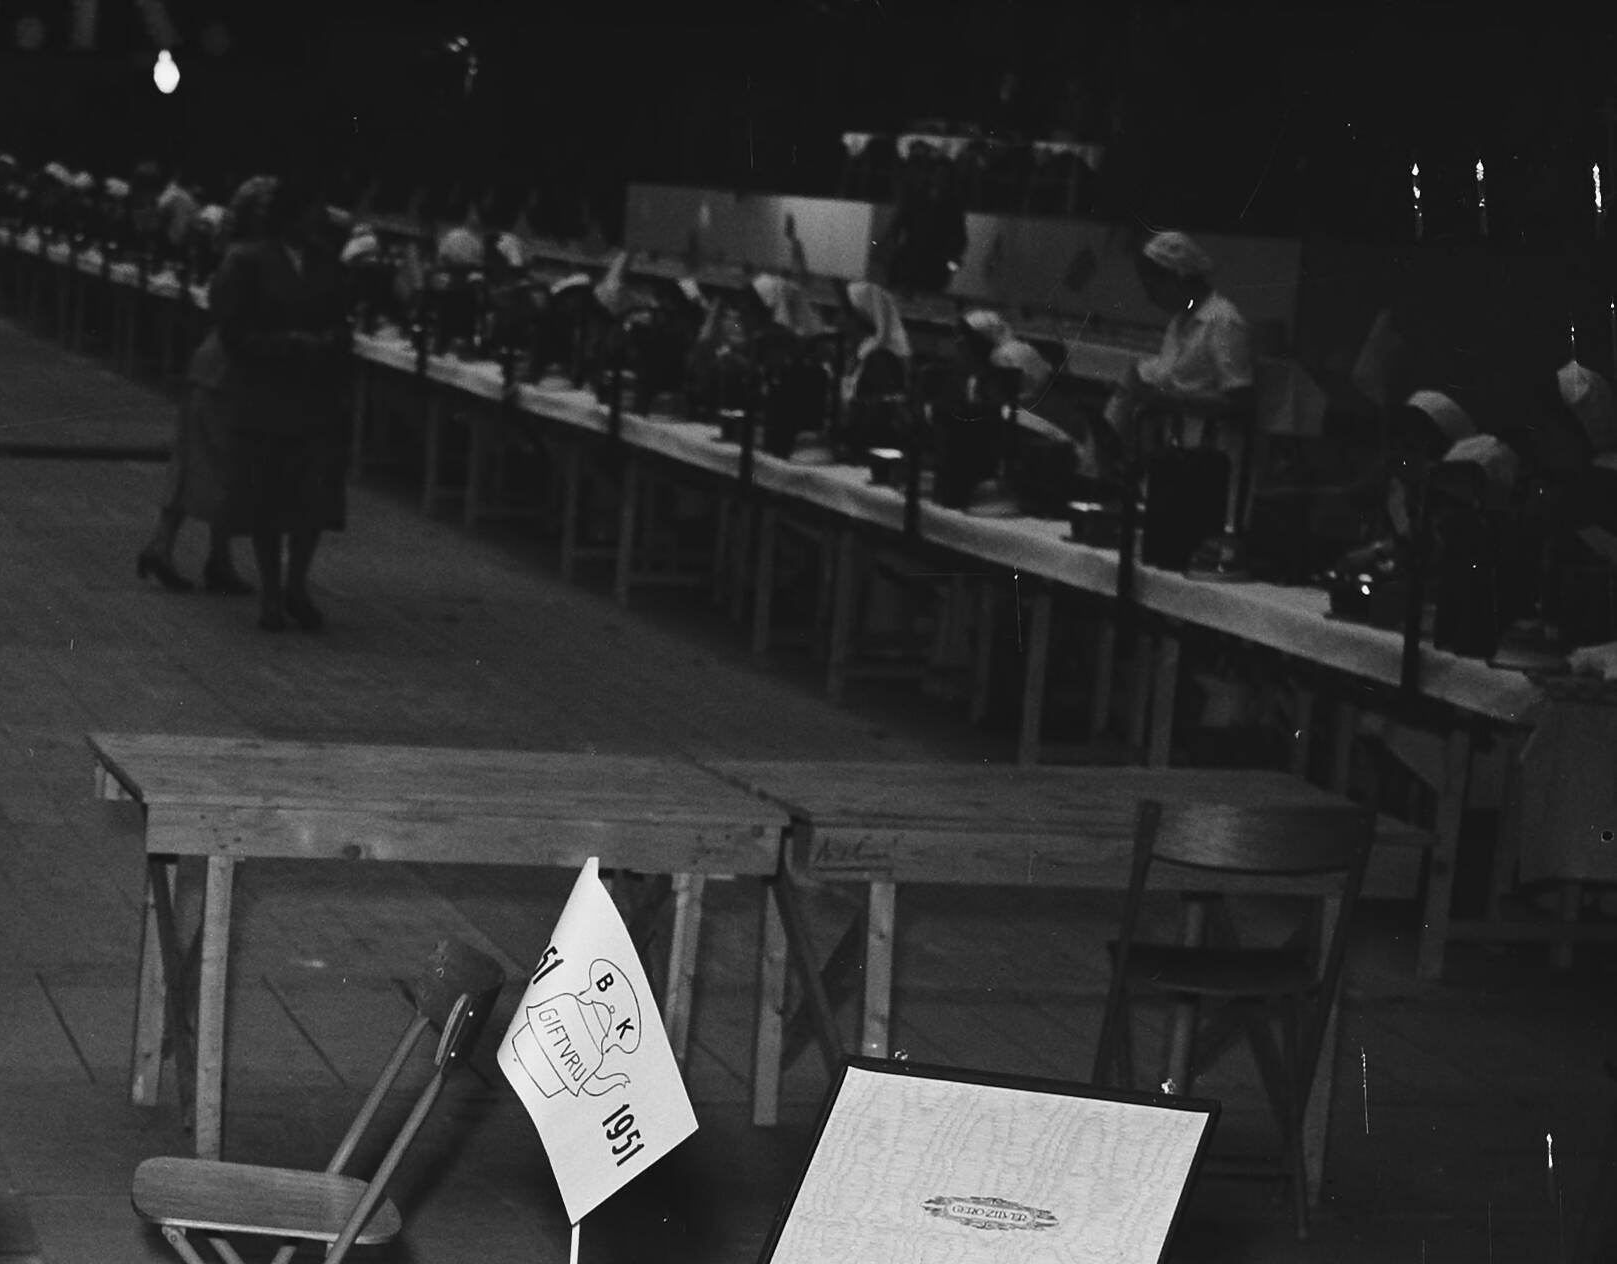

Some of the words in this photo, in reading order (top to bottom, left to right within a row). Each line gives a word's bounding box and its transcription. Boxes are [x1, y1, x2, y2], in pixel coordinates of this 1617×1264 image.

[595, 972, 615, 992] B
[615, 1017, 635, 1040] K
[602, 1104, 644, 1166] 1951
